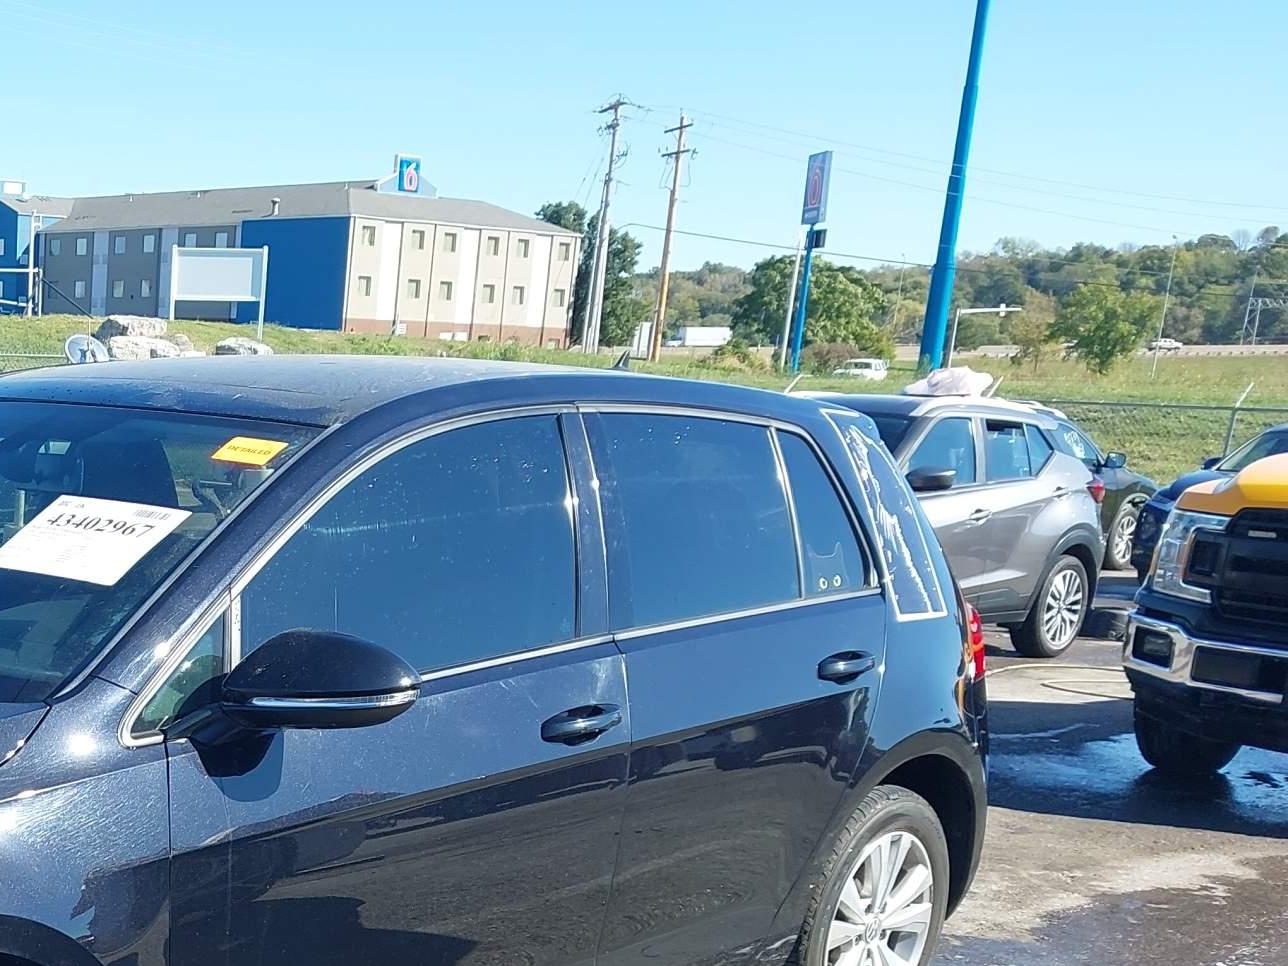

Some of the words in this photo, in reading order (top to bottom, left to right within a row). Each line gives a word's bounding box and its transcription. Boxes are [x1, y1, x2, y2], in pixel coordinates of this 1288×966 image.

[403, 161, 418, 191] 6
[226, 444, 273, 456] DETAILED
[47, 512, 157, 538] 43402967
